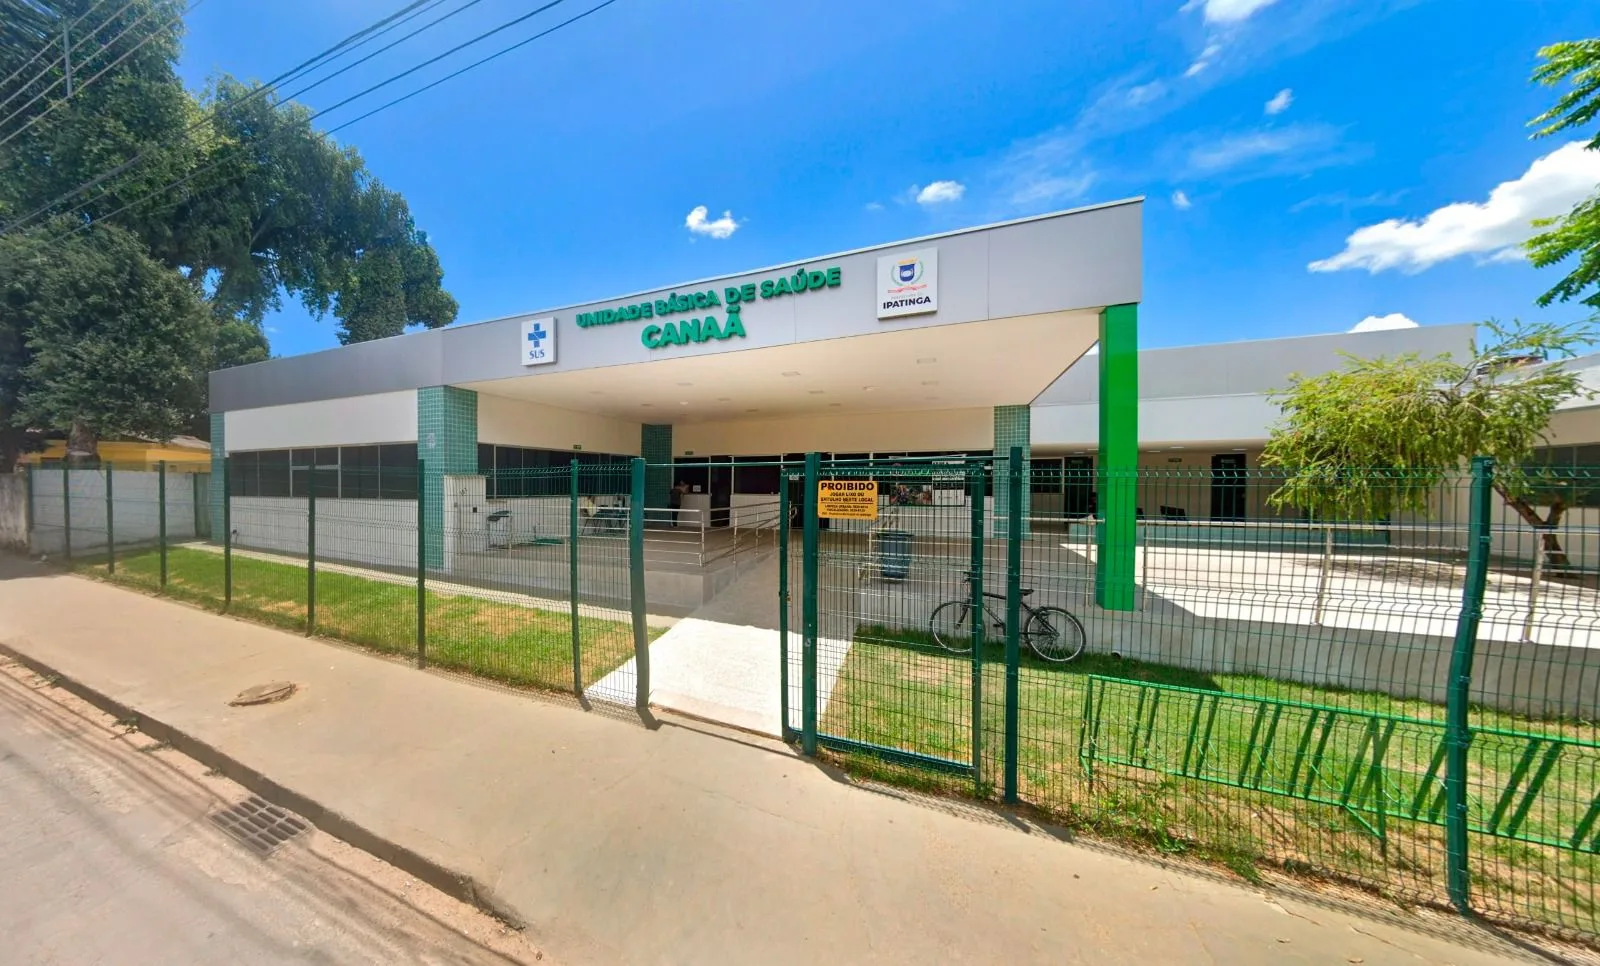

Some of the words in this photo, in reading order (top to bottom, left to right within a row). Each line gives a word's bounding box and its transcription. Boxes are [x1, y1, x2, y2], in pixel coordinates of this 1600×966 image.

[576, 301, 653, 328] UNIDADE
[655, 286, 720, 317] BÁSICA
[725, 285, 757, 305] DE
[760, 266, 841, 299] SAÚDE
[883, 296, 931, 309] IPATINGA
[641, 304, 746, 348] CANAÃ
[529, 349, 545, 360] SUS
[821, 482, 874, 491] PROIBIDO
